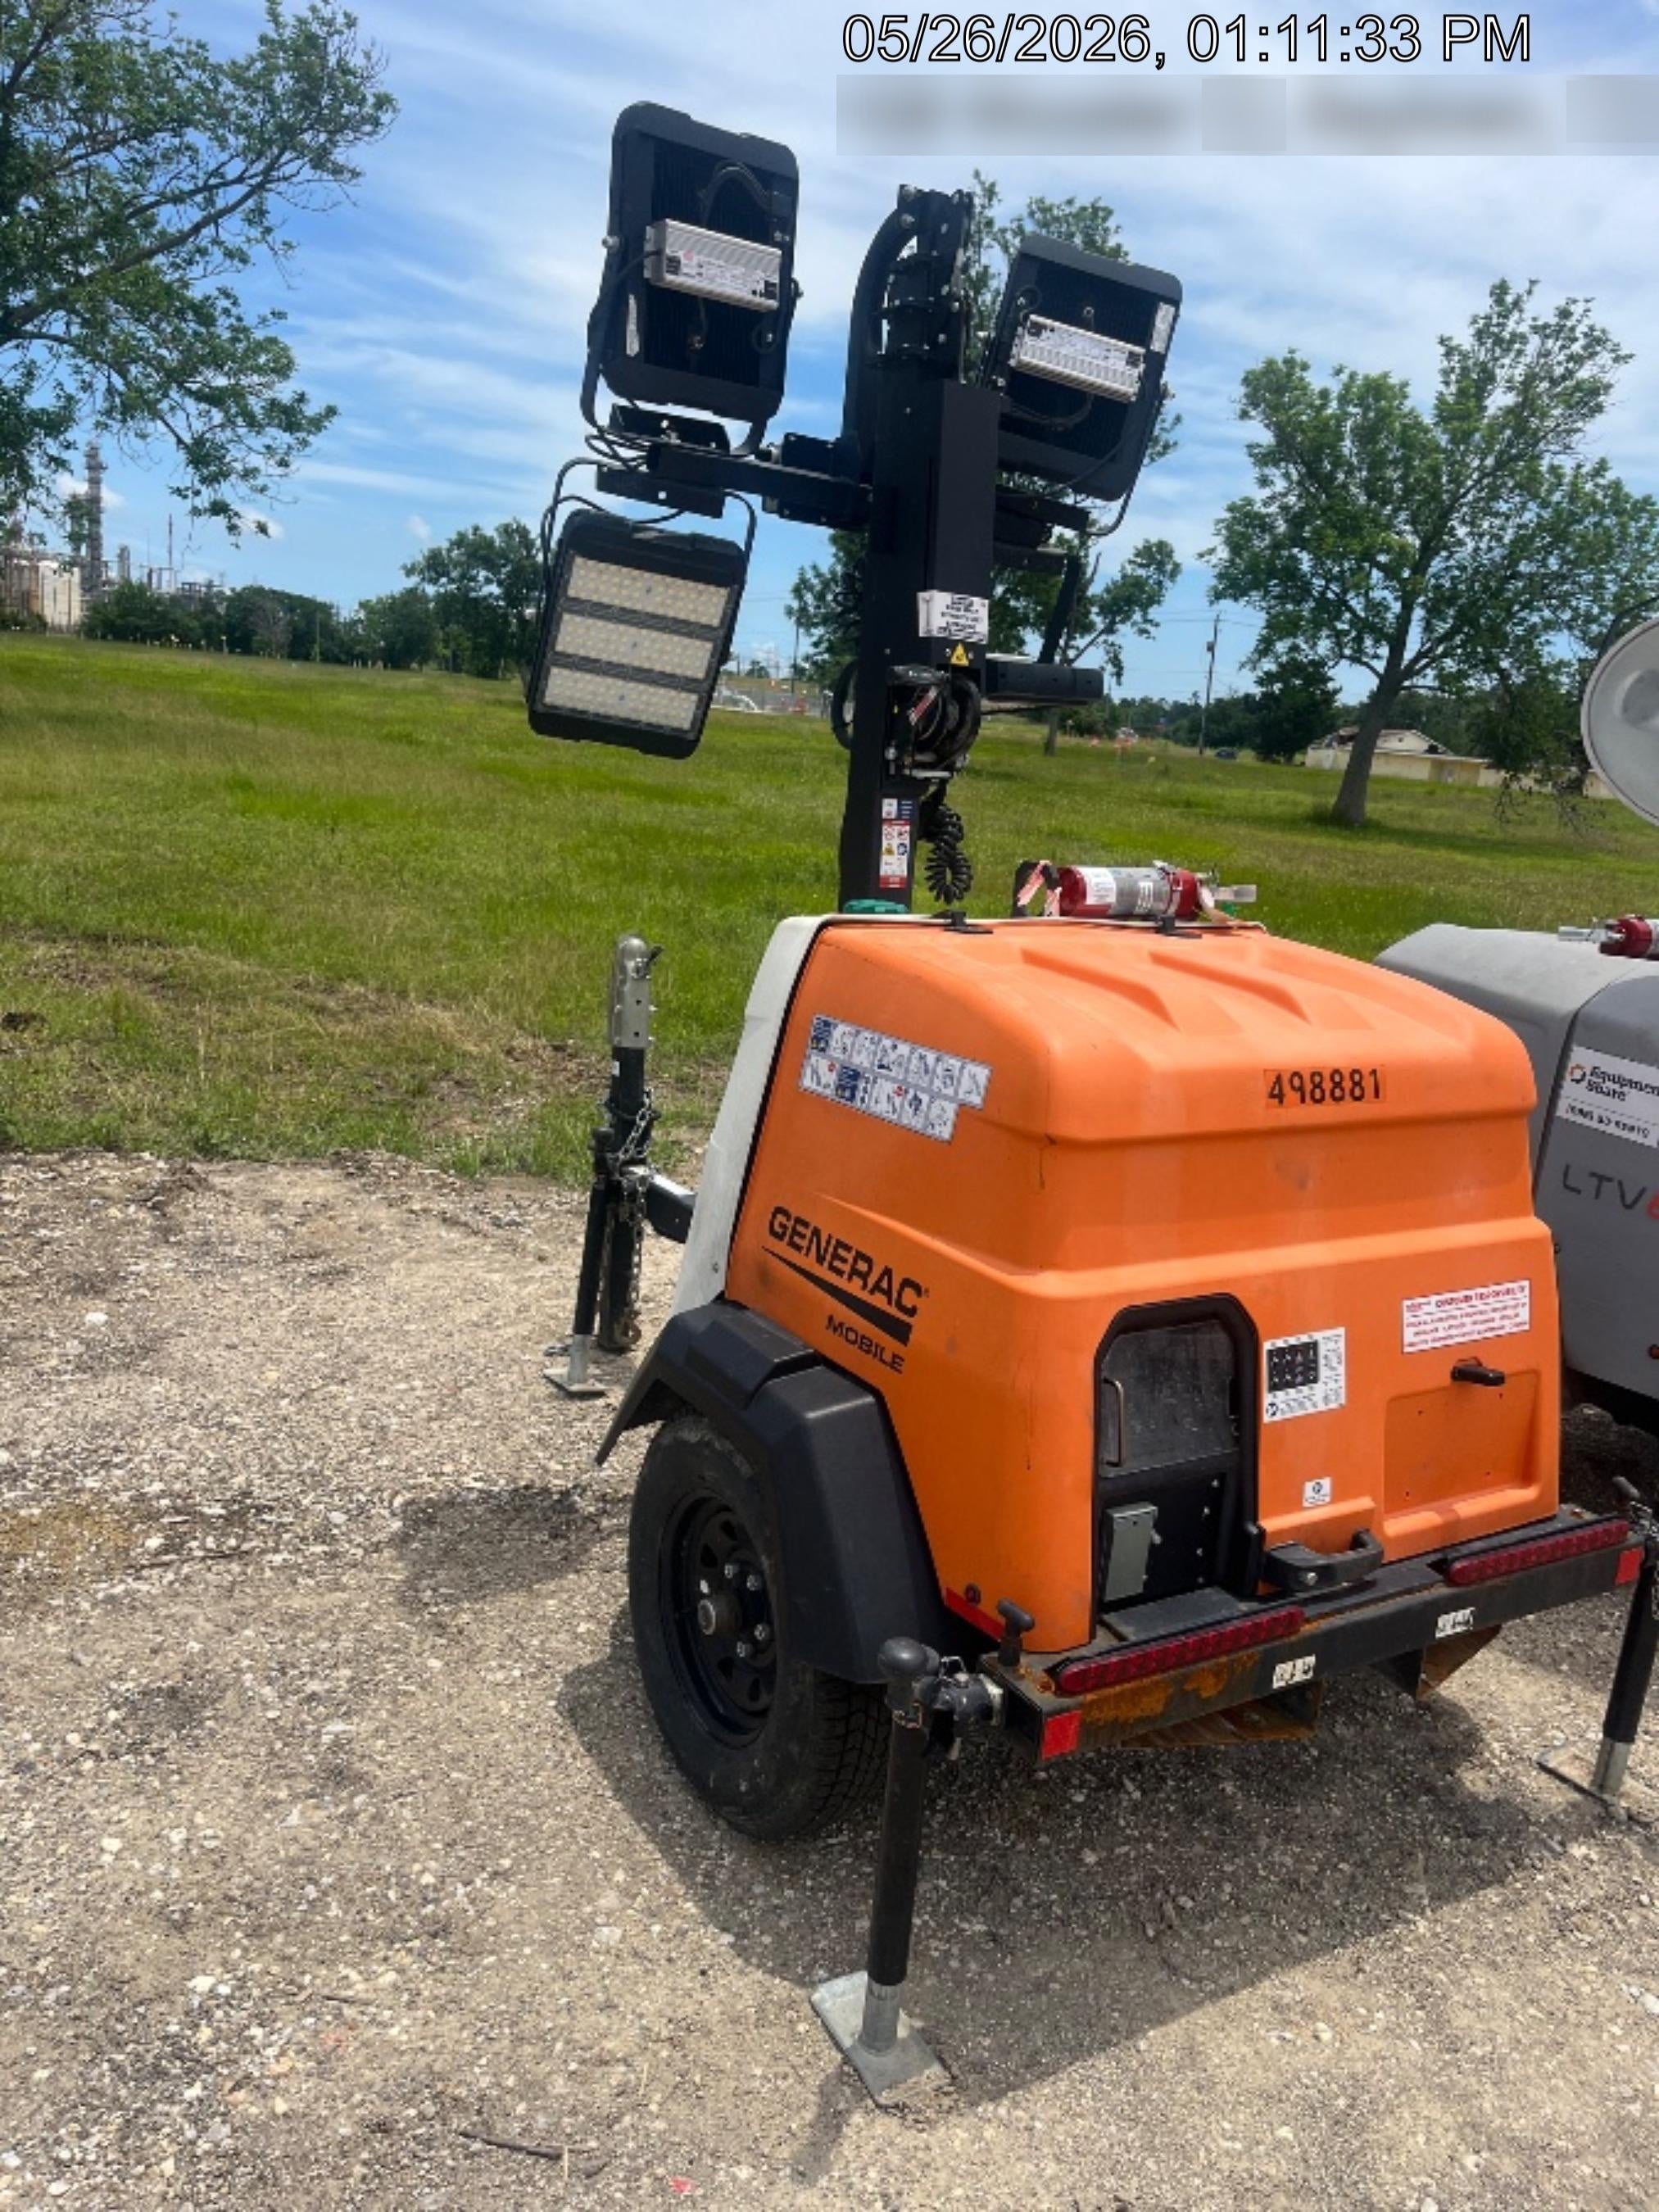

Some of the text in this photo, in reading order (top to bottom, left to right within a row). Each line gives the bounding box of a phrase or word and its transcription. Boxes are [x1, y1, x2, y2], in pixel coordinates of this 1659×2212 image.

[1267, 1067, 1380, 1105] 498881
[1586, 1079, 1626, 1101] Share
[1590, 1066, 1659, 1097] Equipmen
[768, 1206, 924, 1318] GENERAC
[825, 1314, 905, 1375] MOBILE
